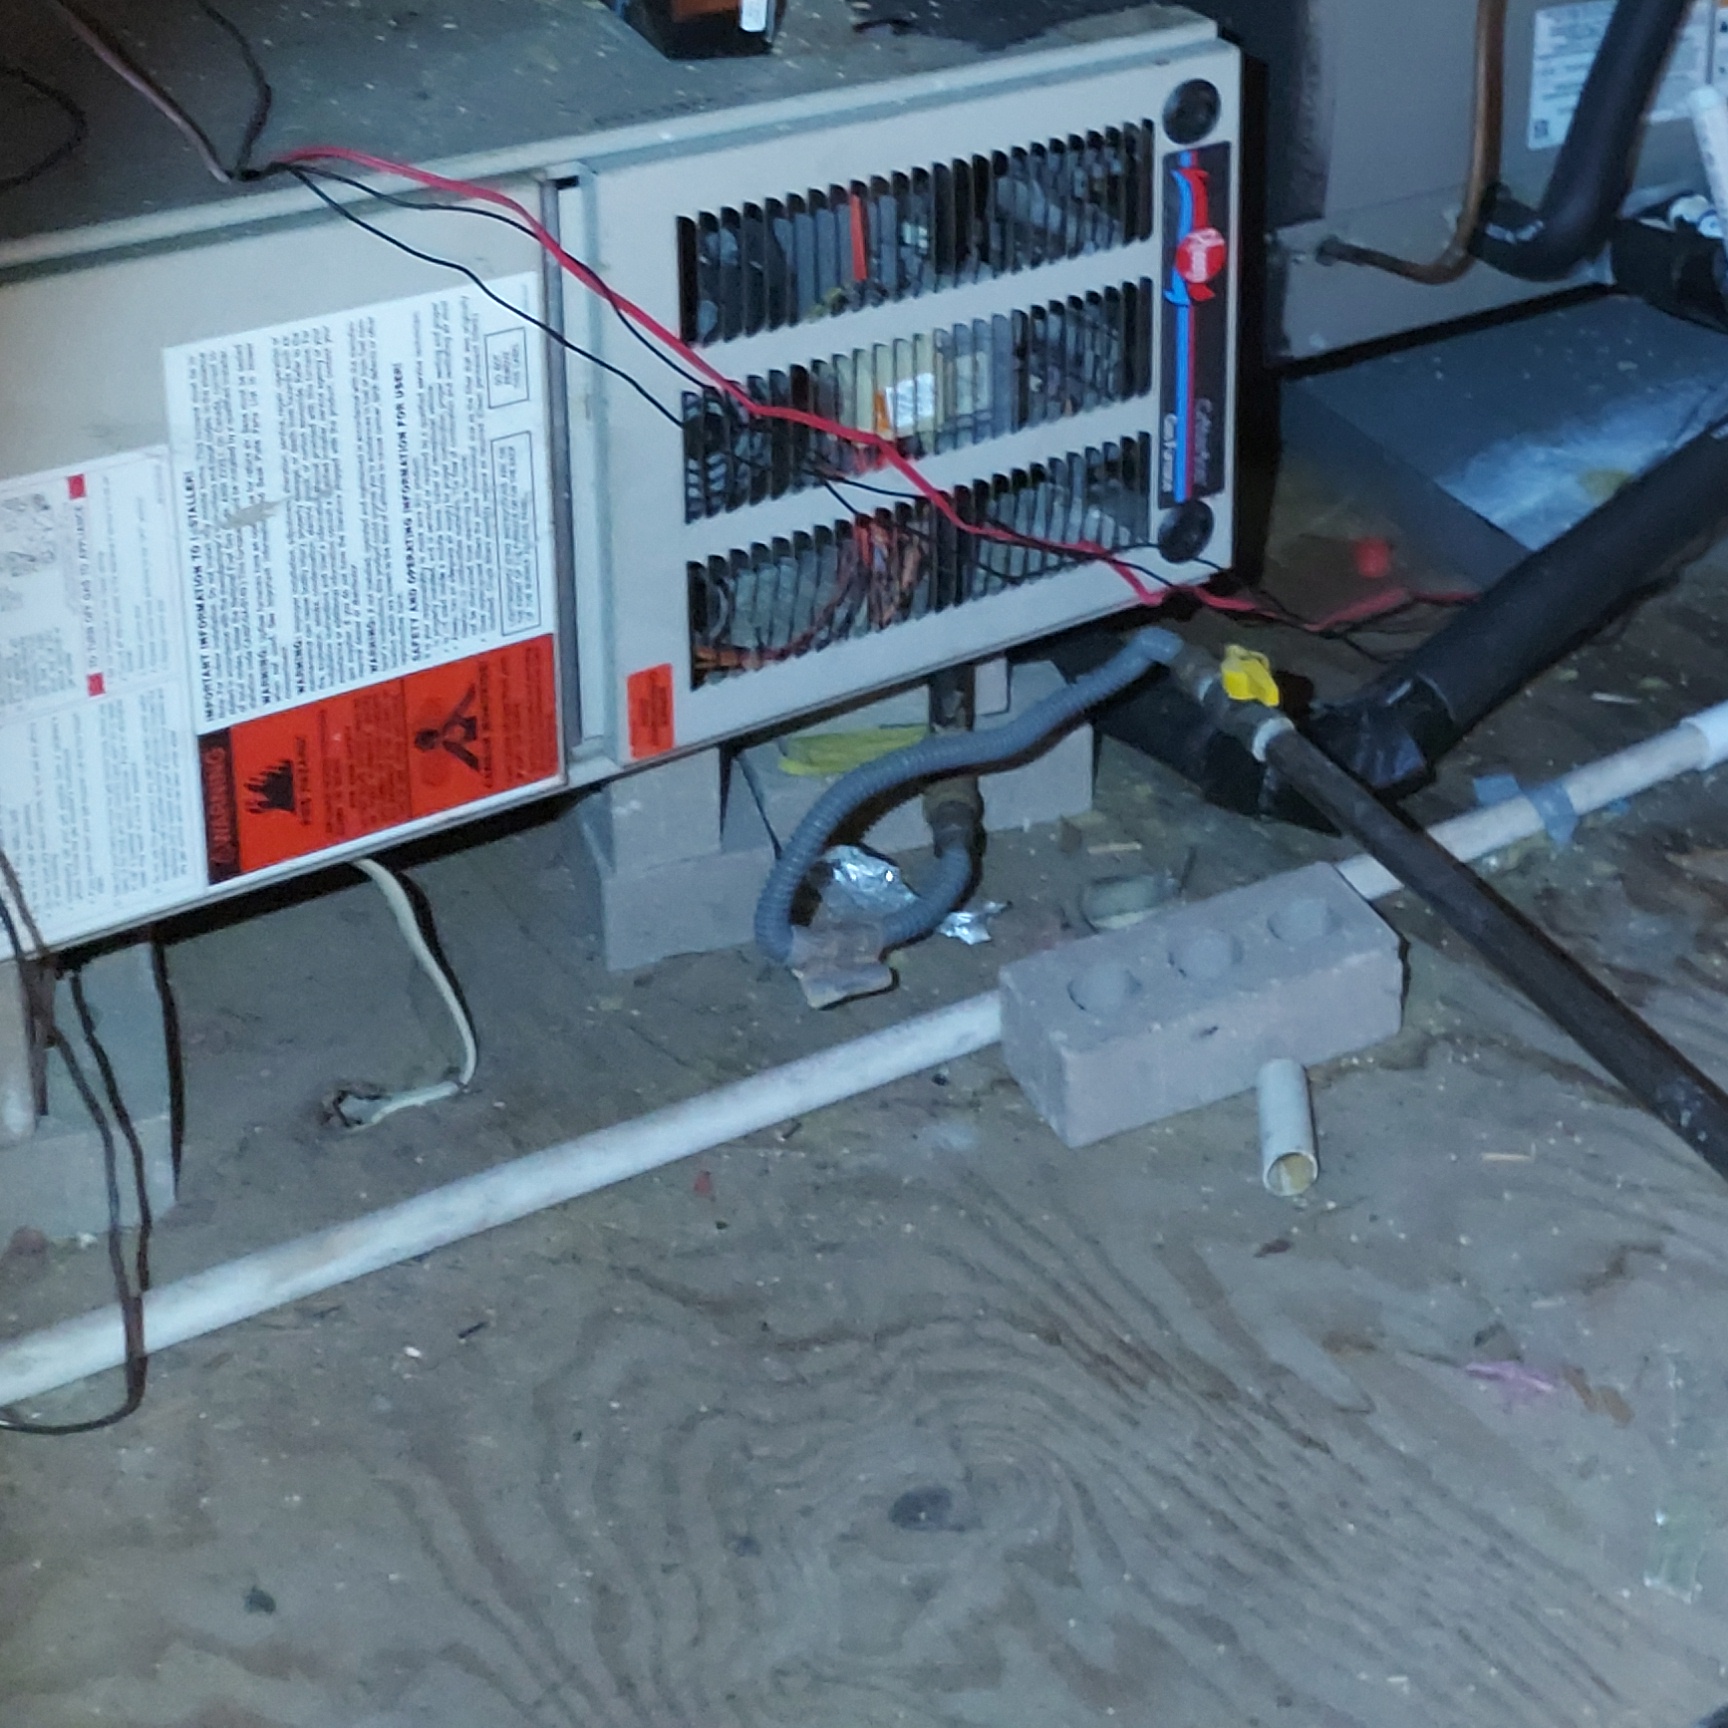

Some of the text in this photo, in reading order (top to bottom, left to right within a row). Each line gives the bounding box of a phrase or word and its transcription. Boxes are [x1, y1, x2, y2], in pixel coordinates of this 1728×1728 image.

[395, 402, 405, 428] FOR
[185, 470, 199, 540] ISTALLER!
[397, 430, 411, 513] INFORMATION
[403, 517, 416, 585] OPERATING
[193, 564, 208, 650] INFORMATION
[408, 587, 418, 613] AND
[410, 616, 421, 661] SAFETY
[200, 653, 214, 722] IMPORTANT
[205, 745, 232, 846] WARNING
